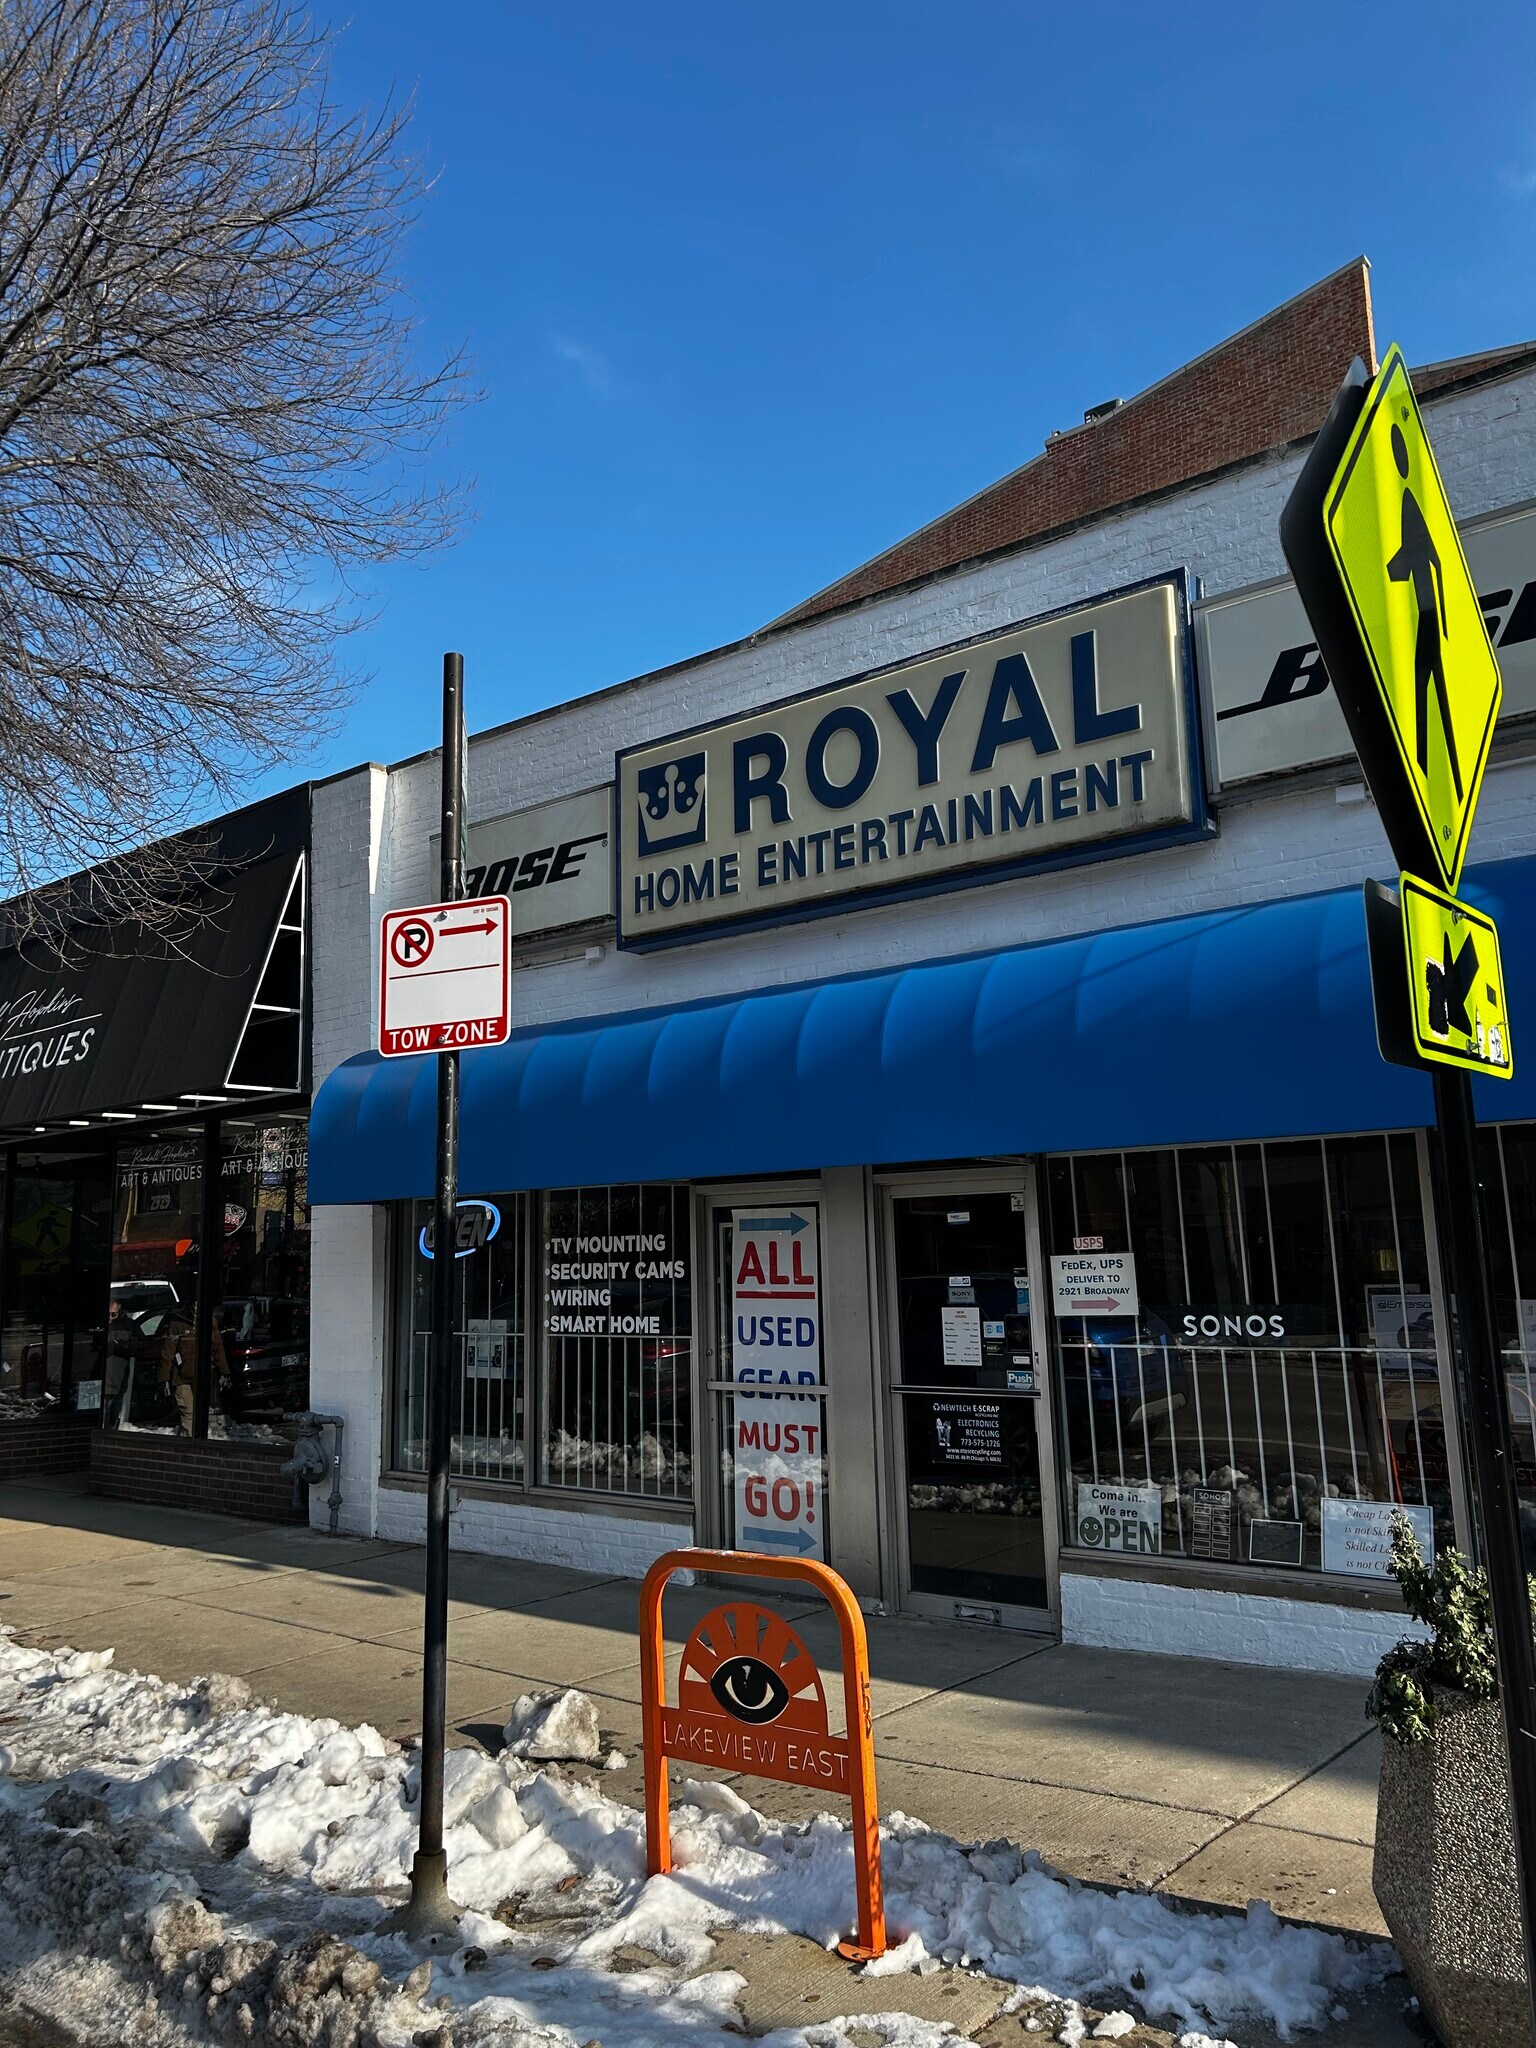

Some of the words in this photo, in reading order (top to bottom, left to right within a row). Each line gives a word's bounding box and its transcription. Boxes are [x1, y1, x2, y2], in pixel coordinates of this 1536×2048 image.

[1217, 581, 1536, 720] BS
[732, 628, 1142, 835] ROYAL
[633, 851, 739, 915] HOME
[757, 748, 1154, 886] ENTERTAINMENT
[389, 1027, 431, 1050] TOW
[442, 1019, 498, 1045] ZONE
[0, 1027, 96, 1080] TIQUES
[220, 1159, 243, 1176] ART
[246, 1158, 253, 1174] &
[256, 1152, 309, 1173] ANTIQUE
[120, 1172, 139, 1188] ART
[142, 1172, 149, 1185] &
[151, 1165, 203, 1185] ANTIQUES
[425, 1212, 490, 1249] OEN
[551, 1237, 573, 1255] TV
[576, 1234, 666, 1254] MOUNTING
[1074, 1237, 1103, 1249] USPS
[551, 1262, 629, 1281] SECURITY
[635, 1260, 685, 1280] CAMS
[736, 1240, 815, 1285] ALL
[1100, 1259, 1123, 1269] UPS
[1066, 1275, 1104, 1284] DELIVER
[1107, 1274, 1120, 1283] TO
[551, 1289, 612, 1307] WIRING
[1059, 1287, 1081, 1295] 2921
[1386, 1301, 1433, 1309] Emerso
[550, 1315, 606, 1334] SMART
[610, 1316, 661, 1334] HOME
[737, 1315, 815, 1348] USED
[1183, 1314, 1285, 1338] SONOS
[738, 1368, 816, 1401] GEAR
[1008, 1372, 1033, 1384] Push
[940, 1403, 972, 1412] NEWTECH
[972, 1404, 1000, 1413] E-SCRAP
[957, 1418, 1000, 1428] ELECTRONICS
[738, 1420, 819, 1455] MUST
[965, 1428, 1000, 1438] RECYCLING
[960, 1438, 1001, 1448] 773-575-1726
[744, 1475, 816, 1524] GO!
[1091, 1488, 1124, 1502] Come
[1127, 1491, 1146, 1504] in..
[1198, 1491, 1226, 1501] SONOS
[1099, 1504, 1117, 1516] We
[1119, 1508, 1138, 1518] are
[1345, 1507, 1375, 1520] Cheap
[1344, 1525, 1352, 1534] is
[1355, 1527, 1370, 1536] not
[1345, 1541, 1377, 1553] Skilled
[1346, 1559, 1354, 1568] is
[1356, 1561, 1371, 1569] not
[663, 1720, 777, 1765] LAKEVIEW
[787, 1744, 849, 1780] EAST
